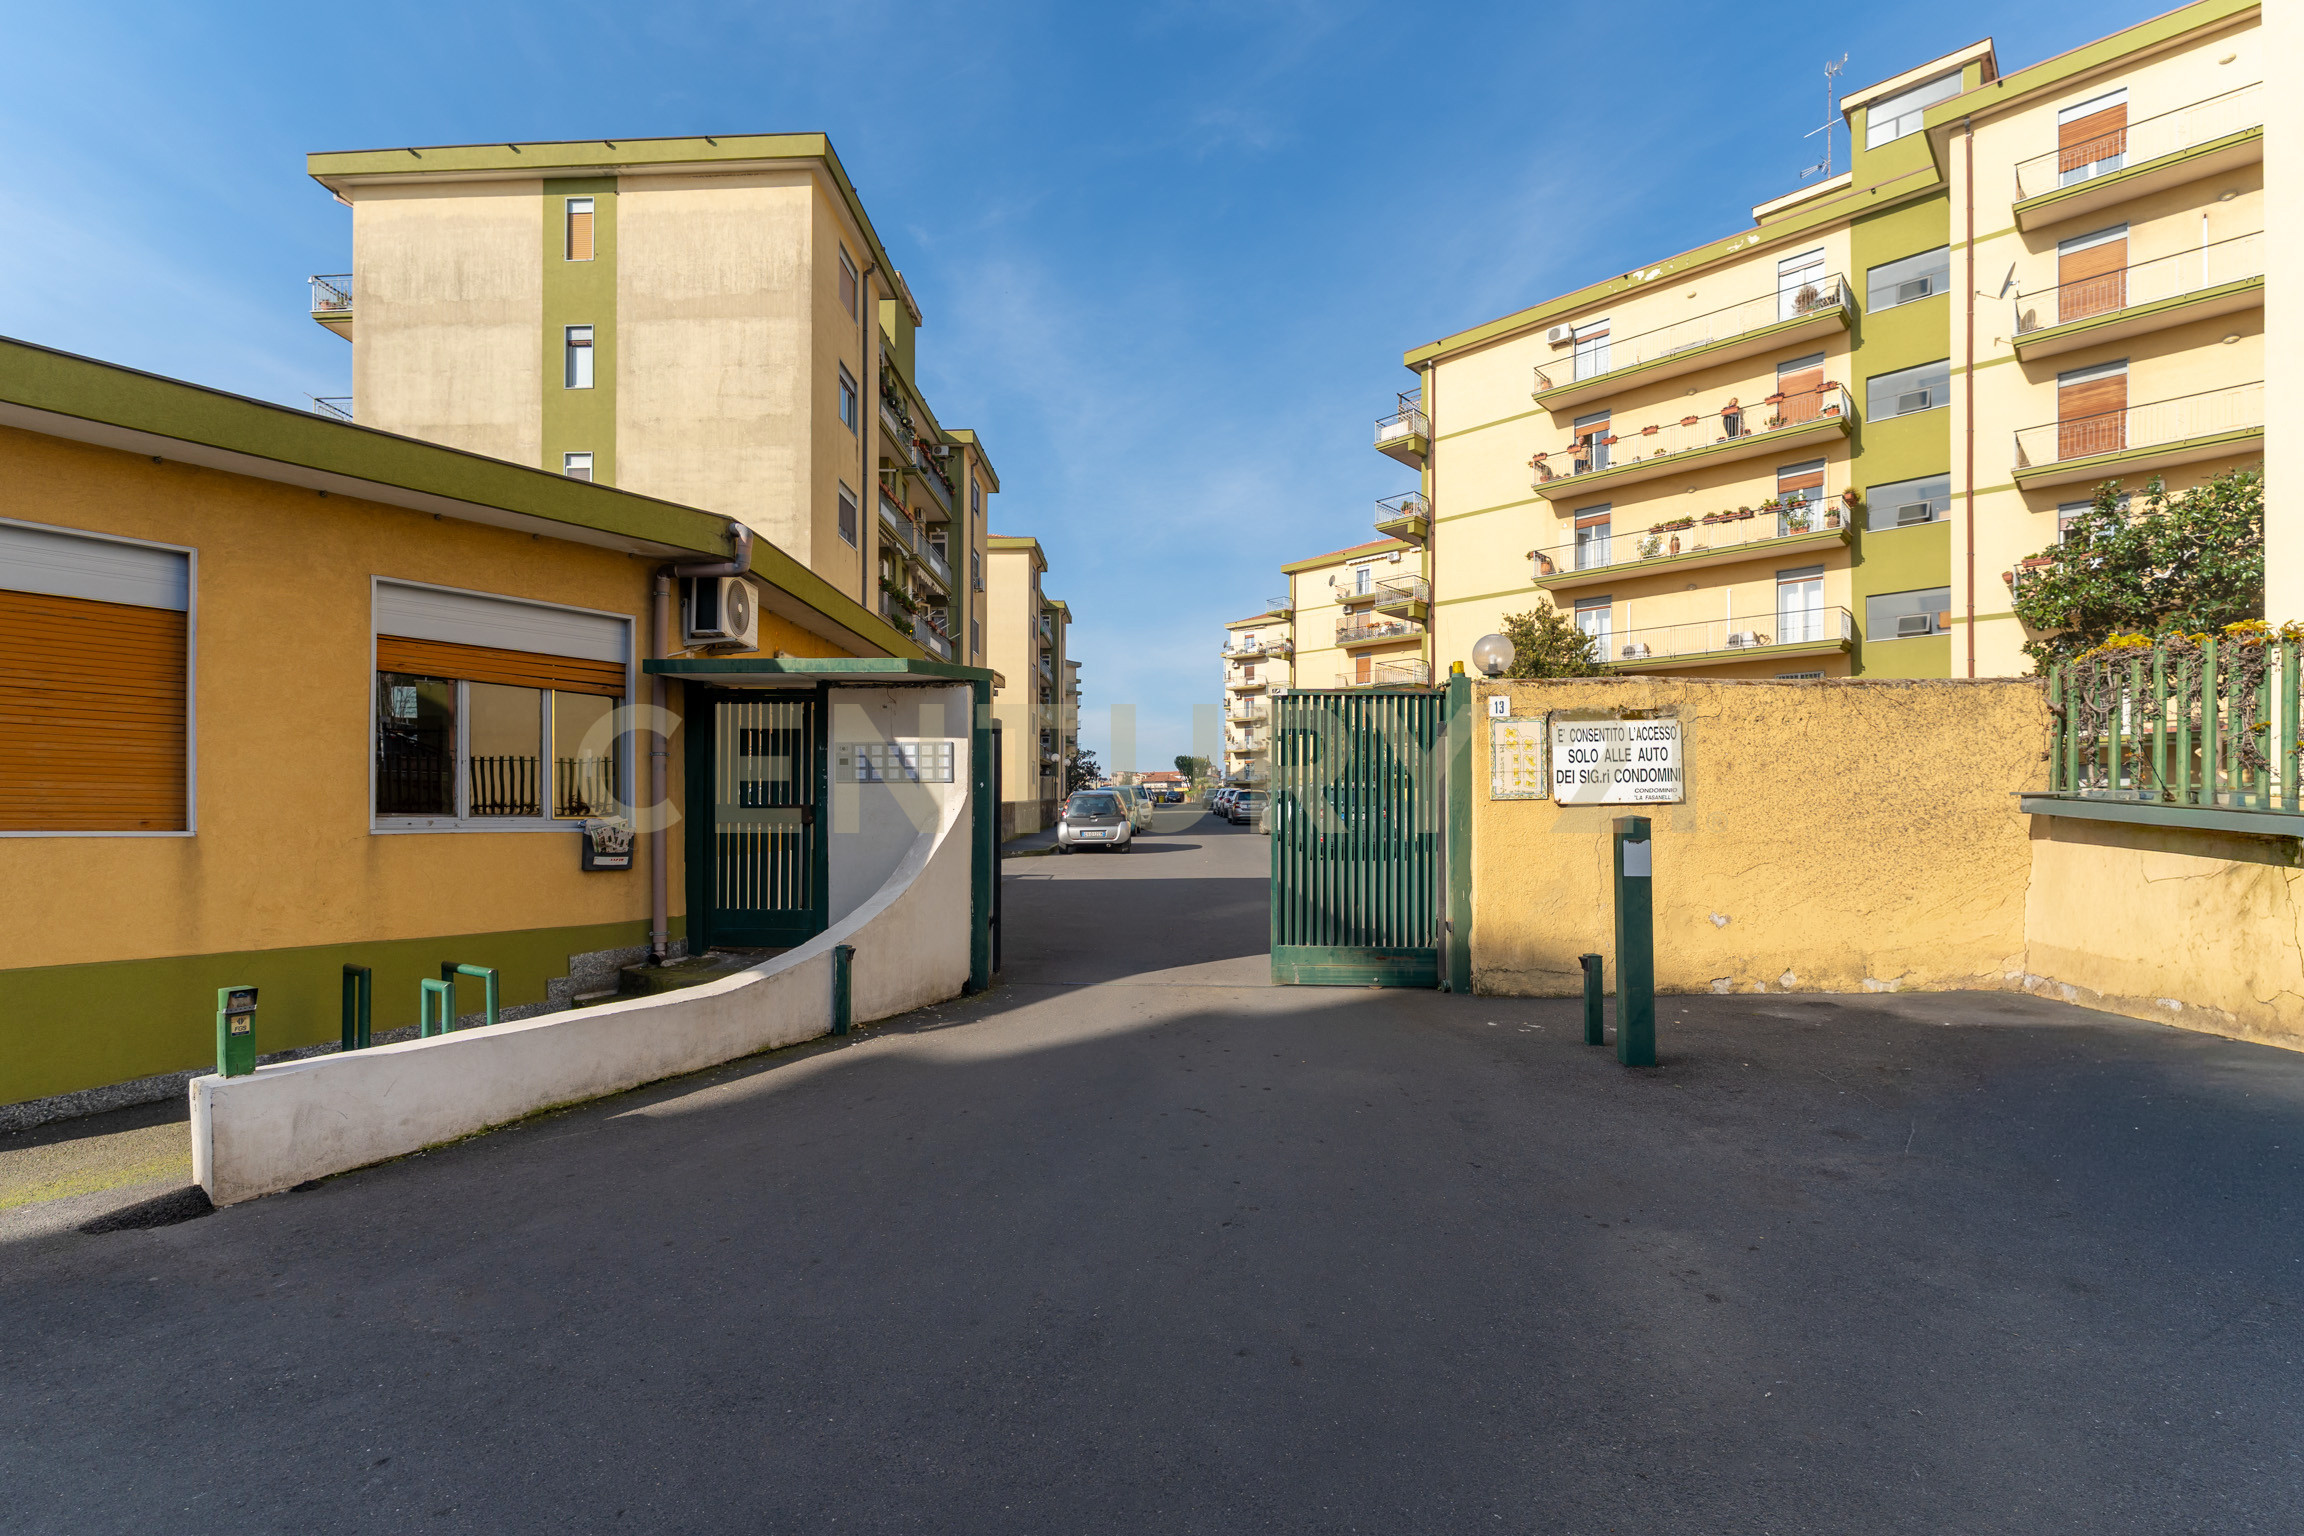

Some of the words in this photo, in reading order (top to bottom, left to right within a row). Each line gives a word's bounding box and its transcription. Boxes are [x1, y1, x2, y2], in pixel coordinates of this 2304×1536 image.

[1494, 700, 1505, 714] 13
[1557, 728, 1566, 743] E'
[1569, 727, 1625, 743] CONSENTITO
[1628, 725, 1677, 741] L'ACCESSO
[1567, 748, 1599, 764] SOLO
[1604, 747, 1632, 763] ALLE
[1637, 746, 1669, 762] AUTO
[1556, 769, 1575, 784] DEI
[1579, 768, 1610, 784] SIG.ri
[1614, 767, 1681, 784] CONDOMINI
